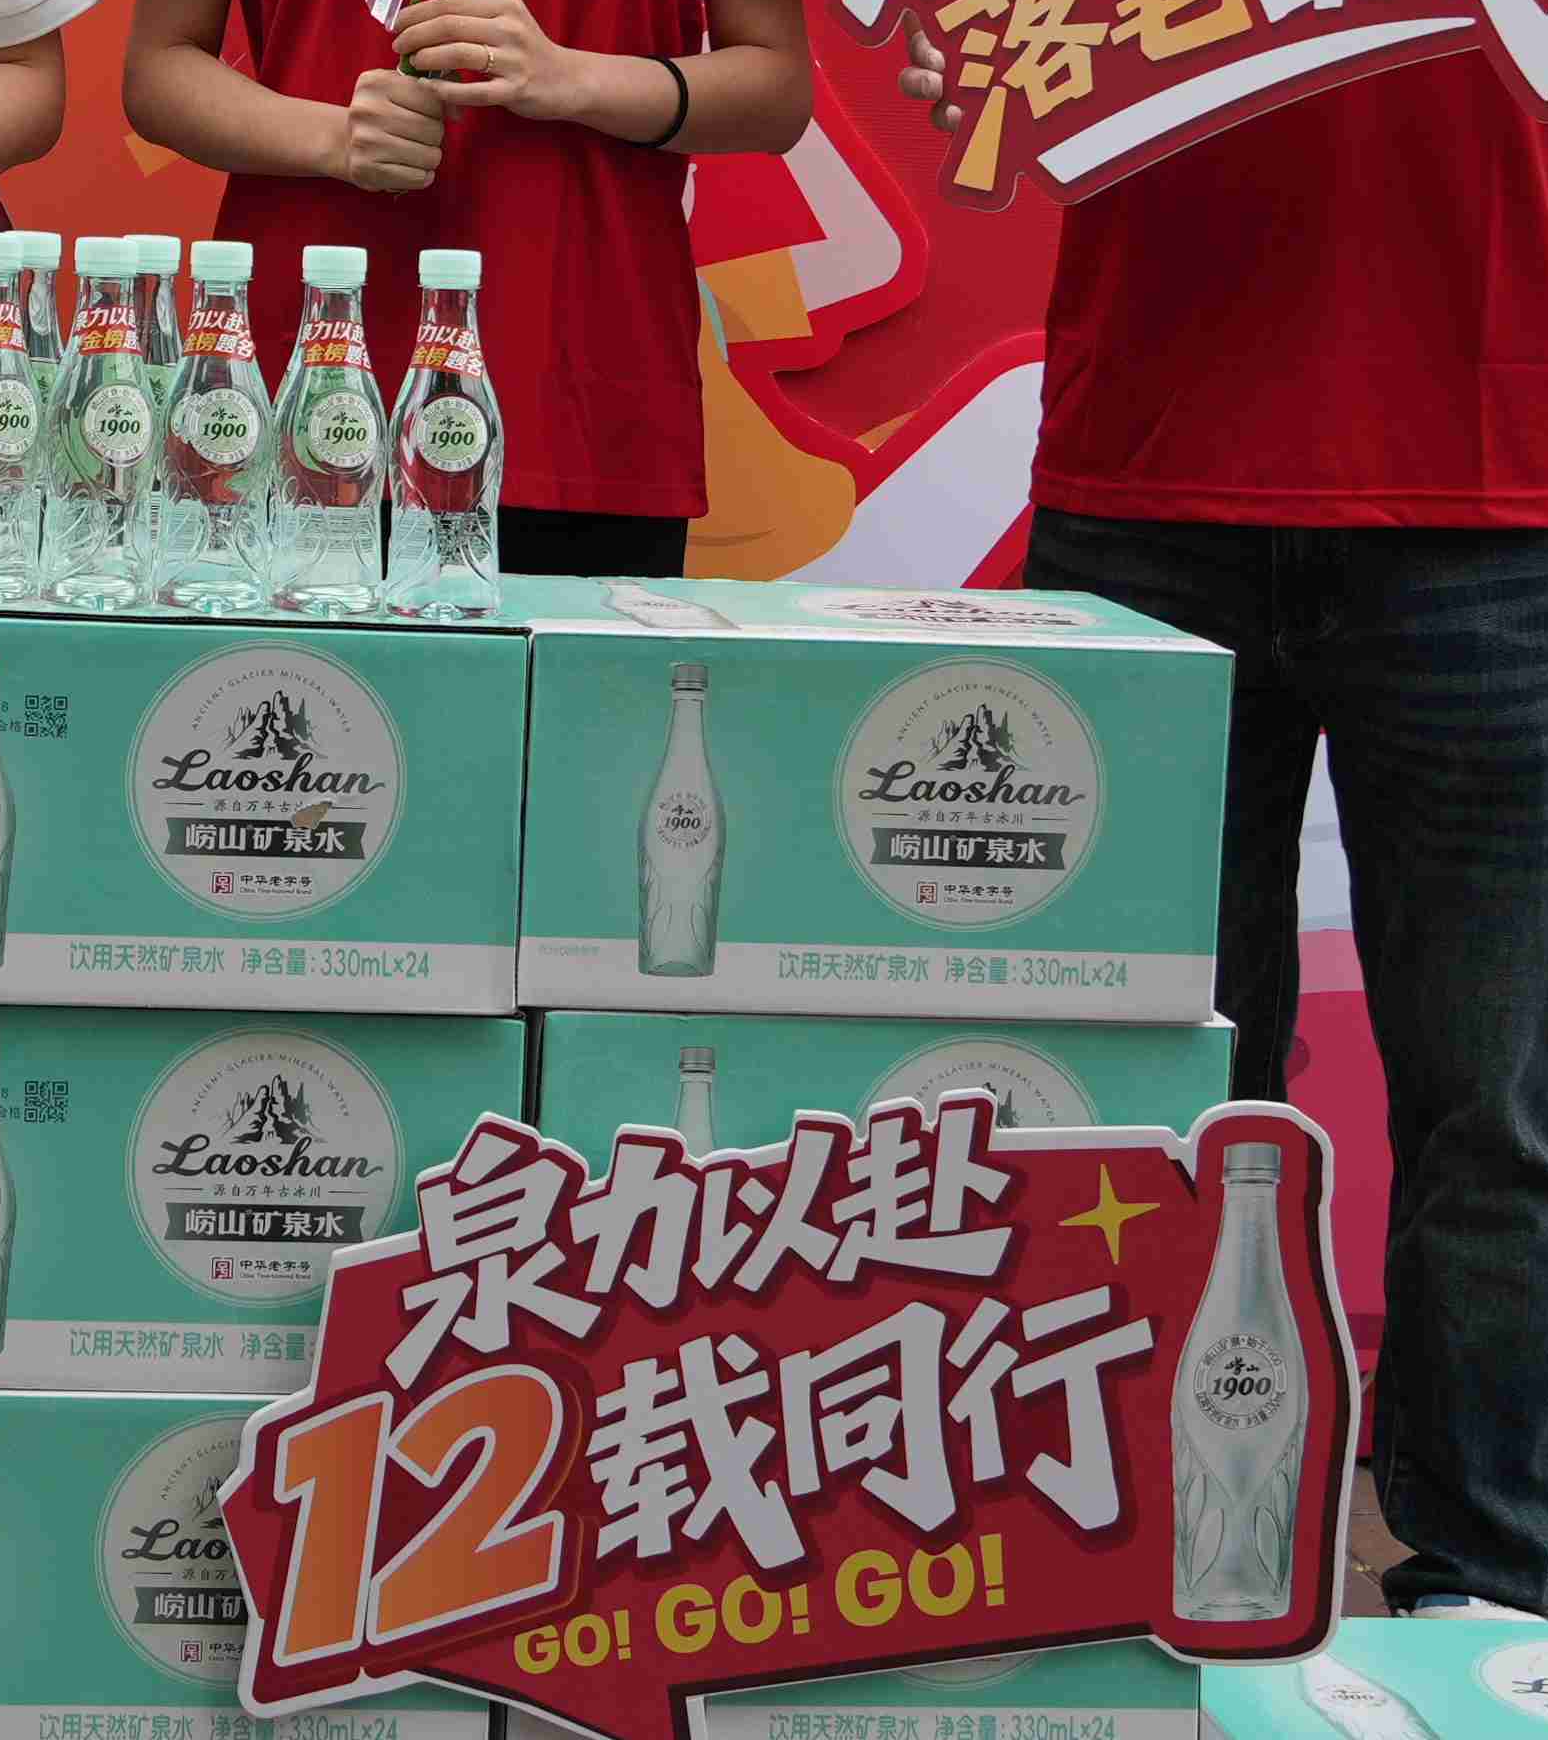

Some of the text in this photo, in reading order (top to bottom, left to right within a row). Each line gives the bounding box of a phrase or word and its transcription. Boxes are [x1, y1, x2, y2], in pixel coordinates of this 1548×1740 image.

[99, 419, 140, 436] 1900
[204, 423, 247, 440] 1900
[325, 426, 367, 444] 1900
[430, 430, 474, 449] 1900
[153, 749, 385, 794] Laoshan
[860, 761, 1084, 805] Laoshan
[214, 799, 302, 813] 源自万年古
[666, 816, 701, 830] 1900
[69, 940, 224, 973] 饮用天然矿泉水
[778, 949, 928, 982] 饮用天然矿泉水
[153, 1134, 383, 1178] Laoshan
[385, 1108, 1017, 1388] 泉力以赴
[69, 1326, 224, 1359] 饮用天然矿泉水
[1211, 1377, 1271, 1400] 1900
[154, 1591, 244, 1620] 崂山矿
[513, 1535, 1007, 1675] GO! GO! GO!
[38, 1711, 193, 1740] 饮用天然矿泉水
[768, 1711, 919, 1740] 饮用天然矿泉水
